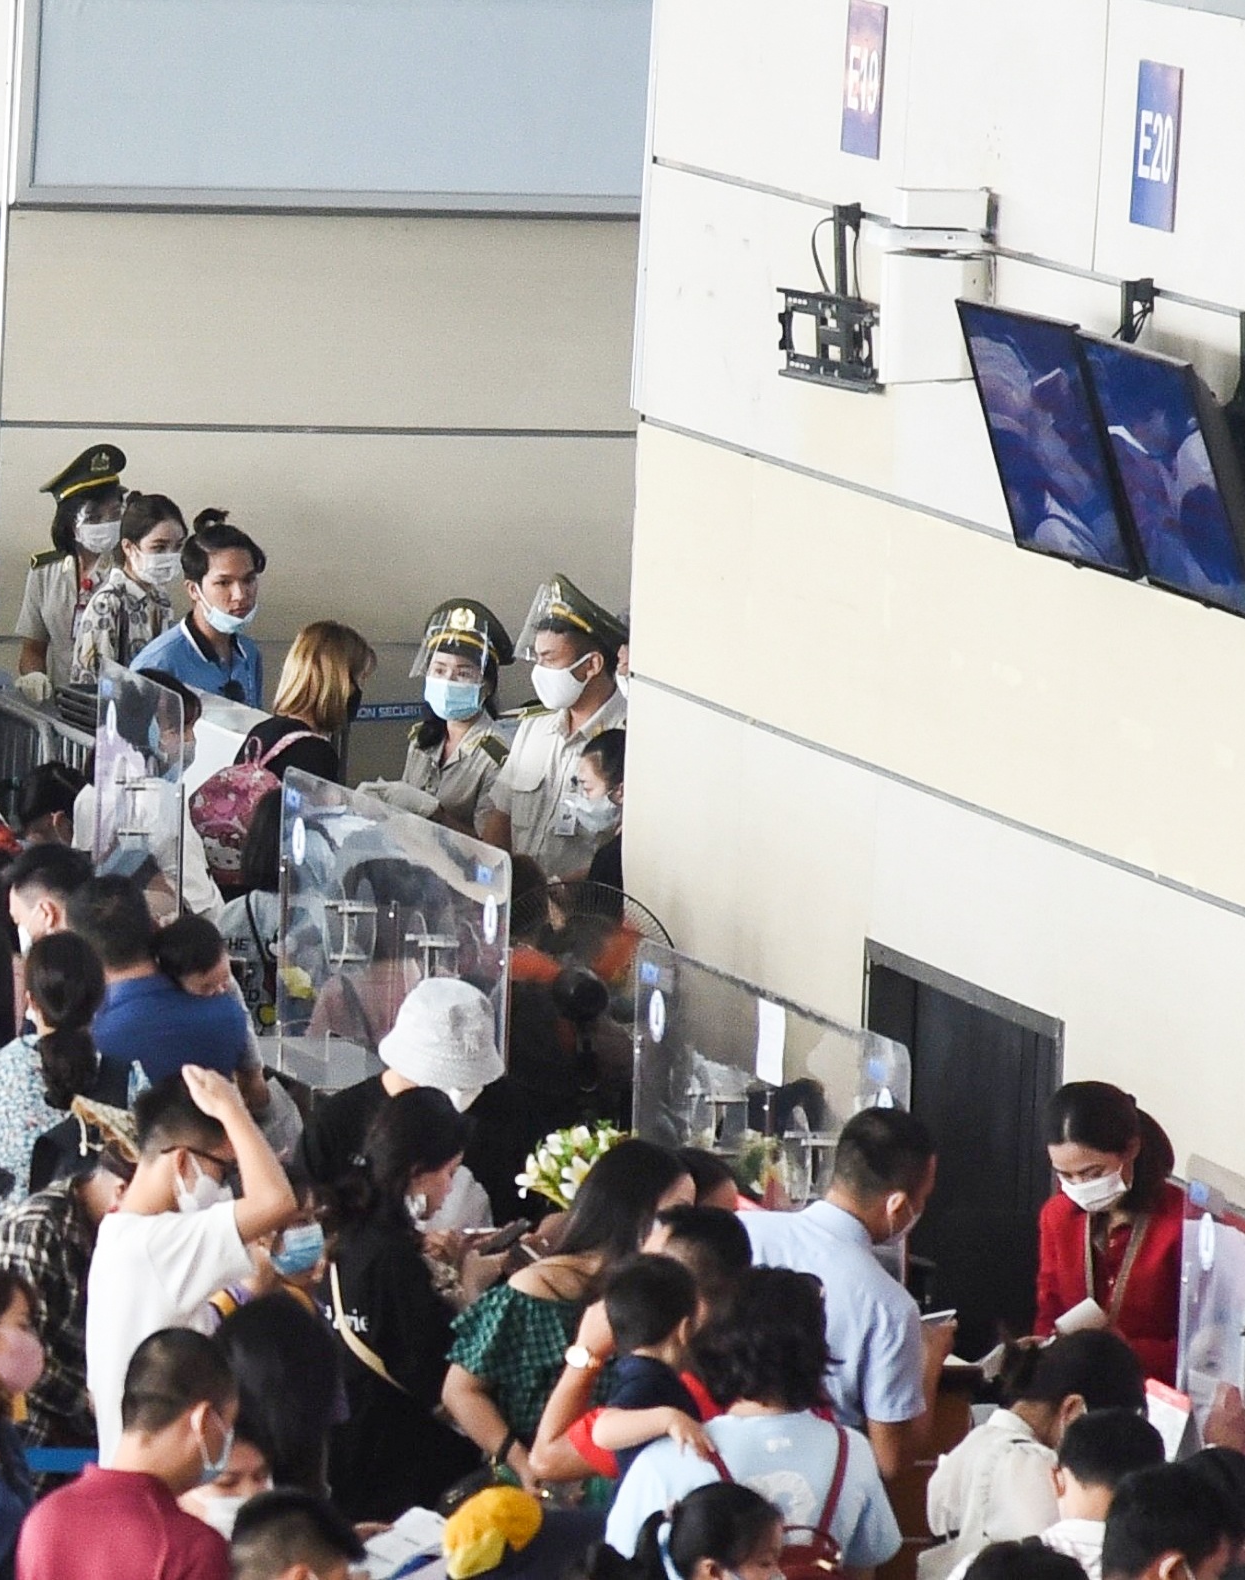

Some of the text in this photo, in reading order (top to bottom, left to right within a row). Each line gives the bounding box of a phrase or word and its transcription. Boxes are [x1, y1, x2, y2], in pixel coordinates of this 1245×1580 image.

[847, 44, 878, 115] E19
[1137, 109, 1173, 185] E20
[378, 705, 424, 717] SECURIT
